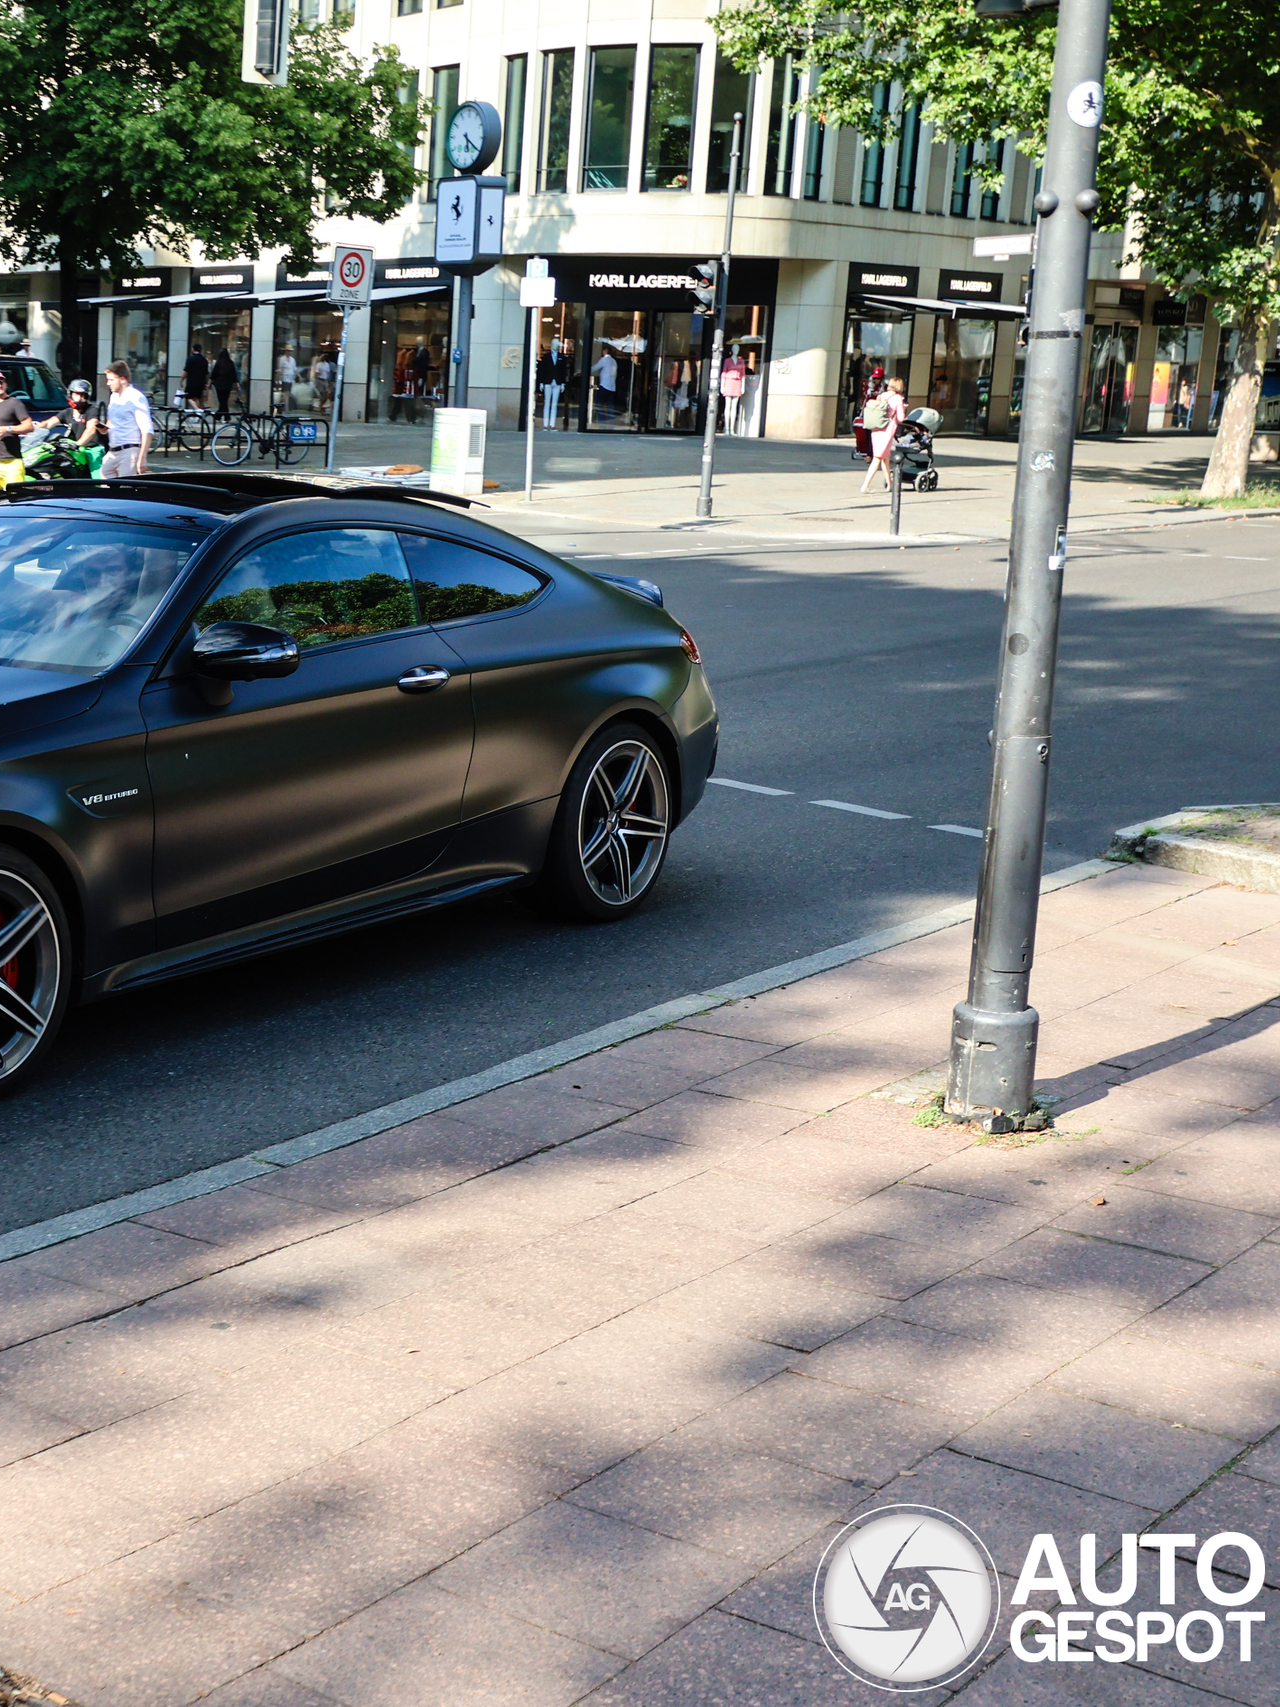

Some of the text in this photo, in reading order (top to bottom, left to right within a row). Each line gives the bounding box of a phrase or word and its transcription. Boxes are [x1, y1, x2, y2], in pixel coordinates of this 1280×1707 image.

[344, 261, 361, 278] 30
[589, 274, 698, 289] KARL LAGERFE
[877, 274, 908, 287] LAGERFELD
[339, 289, 360, 299] ZONE
[82, 788, 139, 806] V8 BITURBO
